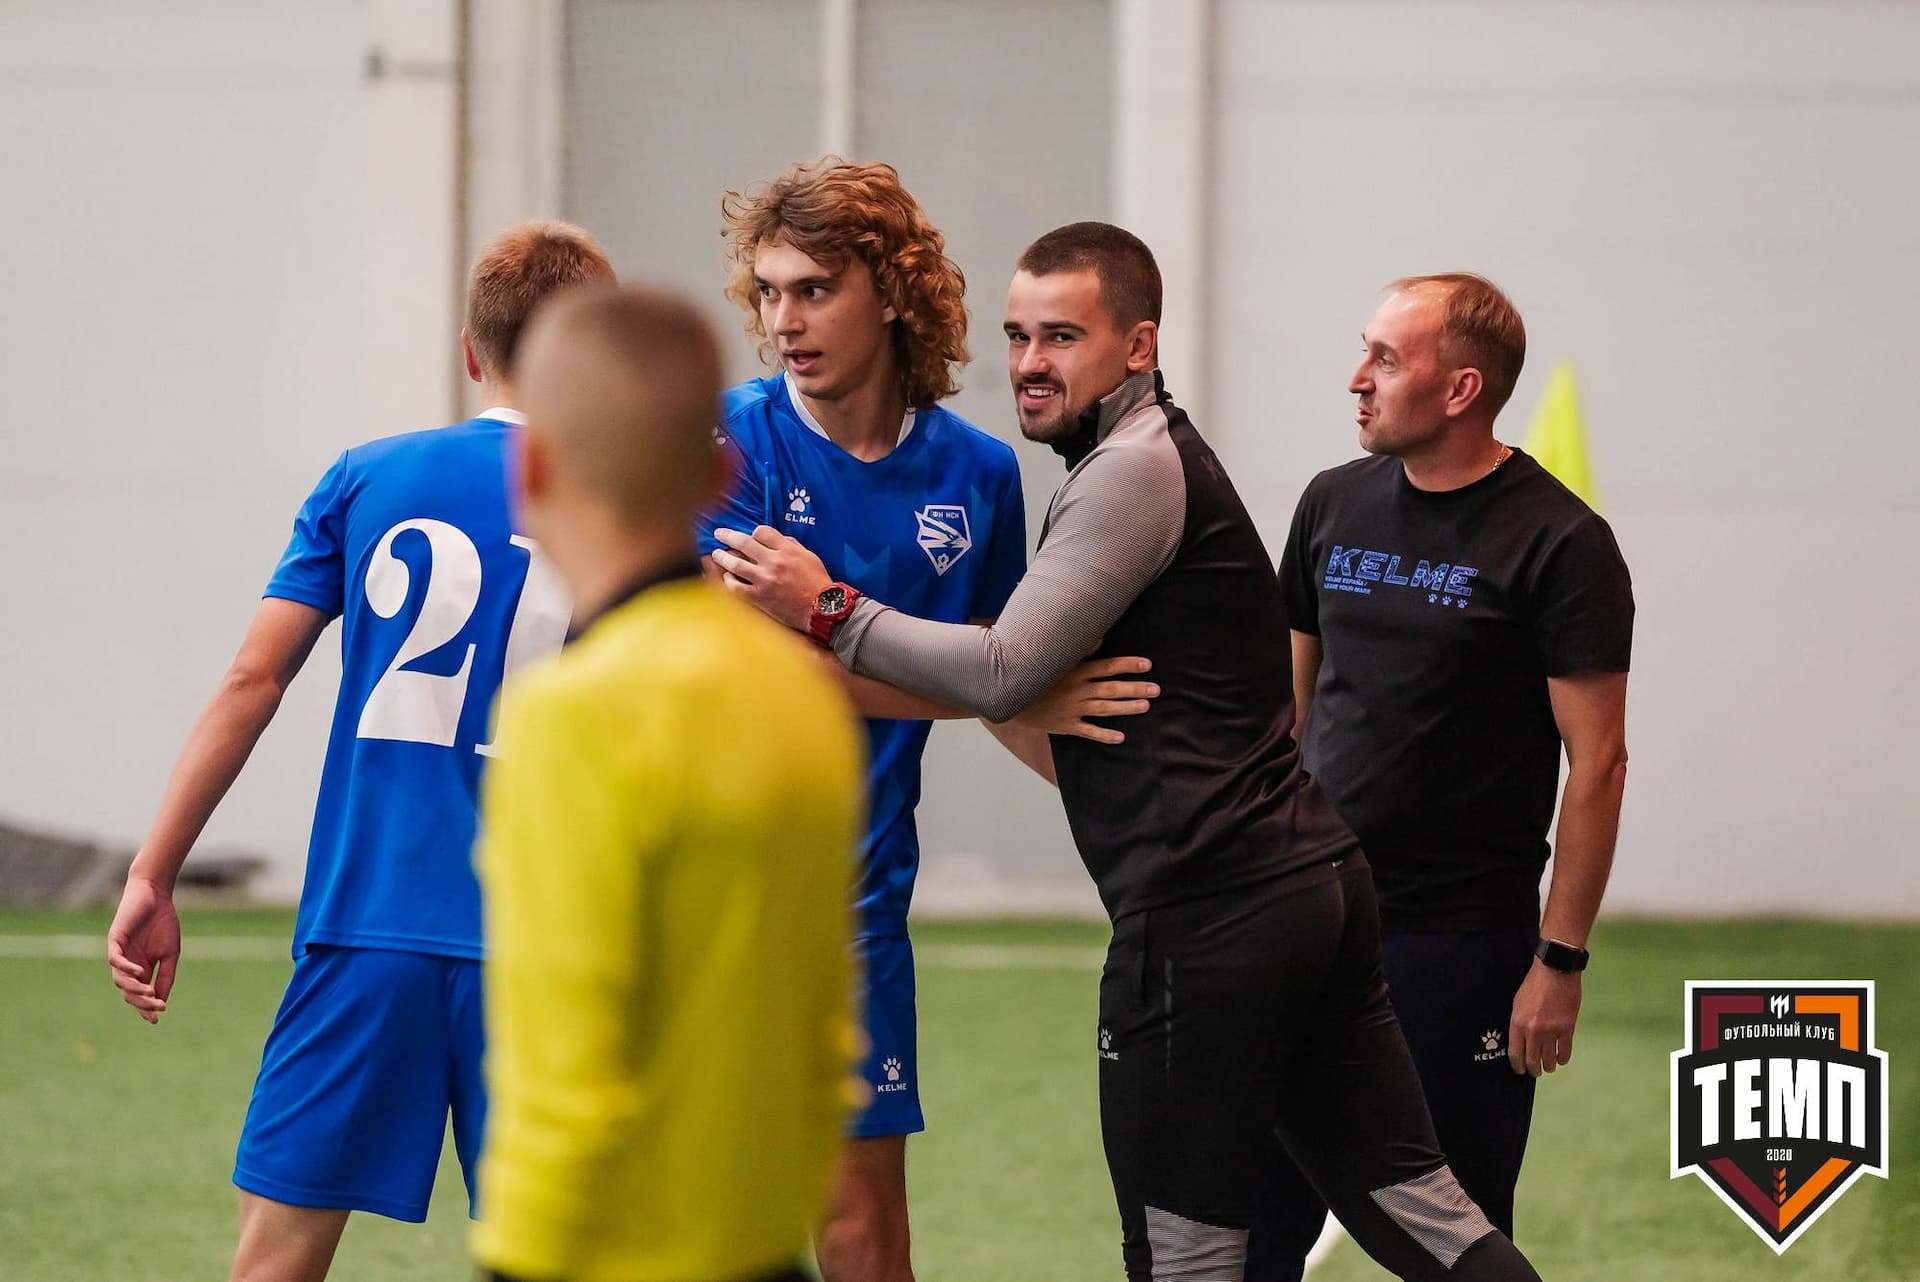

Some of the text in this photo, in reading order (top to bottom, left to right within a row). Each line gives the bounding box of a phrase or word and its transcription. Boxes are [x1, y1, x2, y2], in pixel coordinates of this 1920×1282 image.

[784, 512, 816, 526] ELME
[1326, 546, 1479, 597] KELME
[356, 518, 574, 759] 21
[1474, 1048, 1506, 1062] KELME
[877, 1083, 907, 1093] KELME
